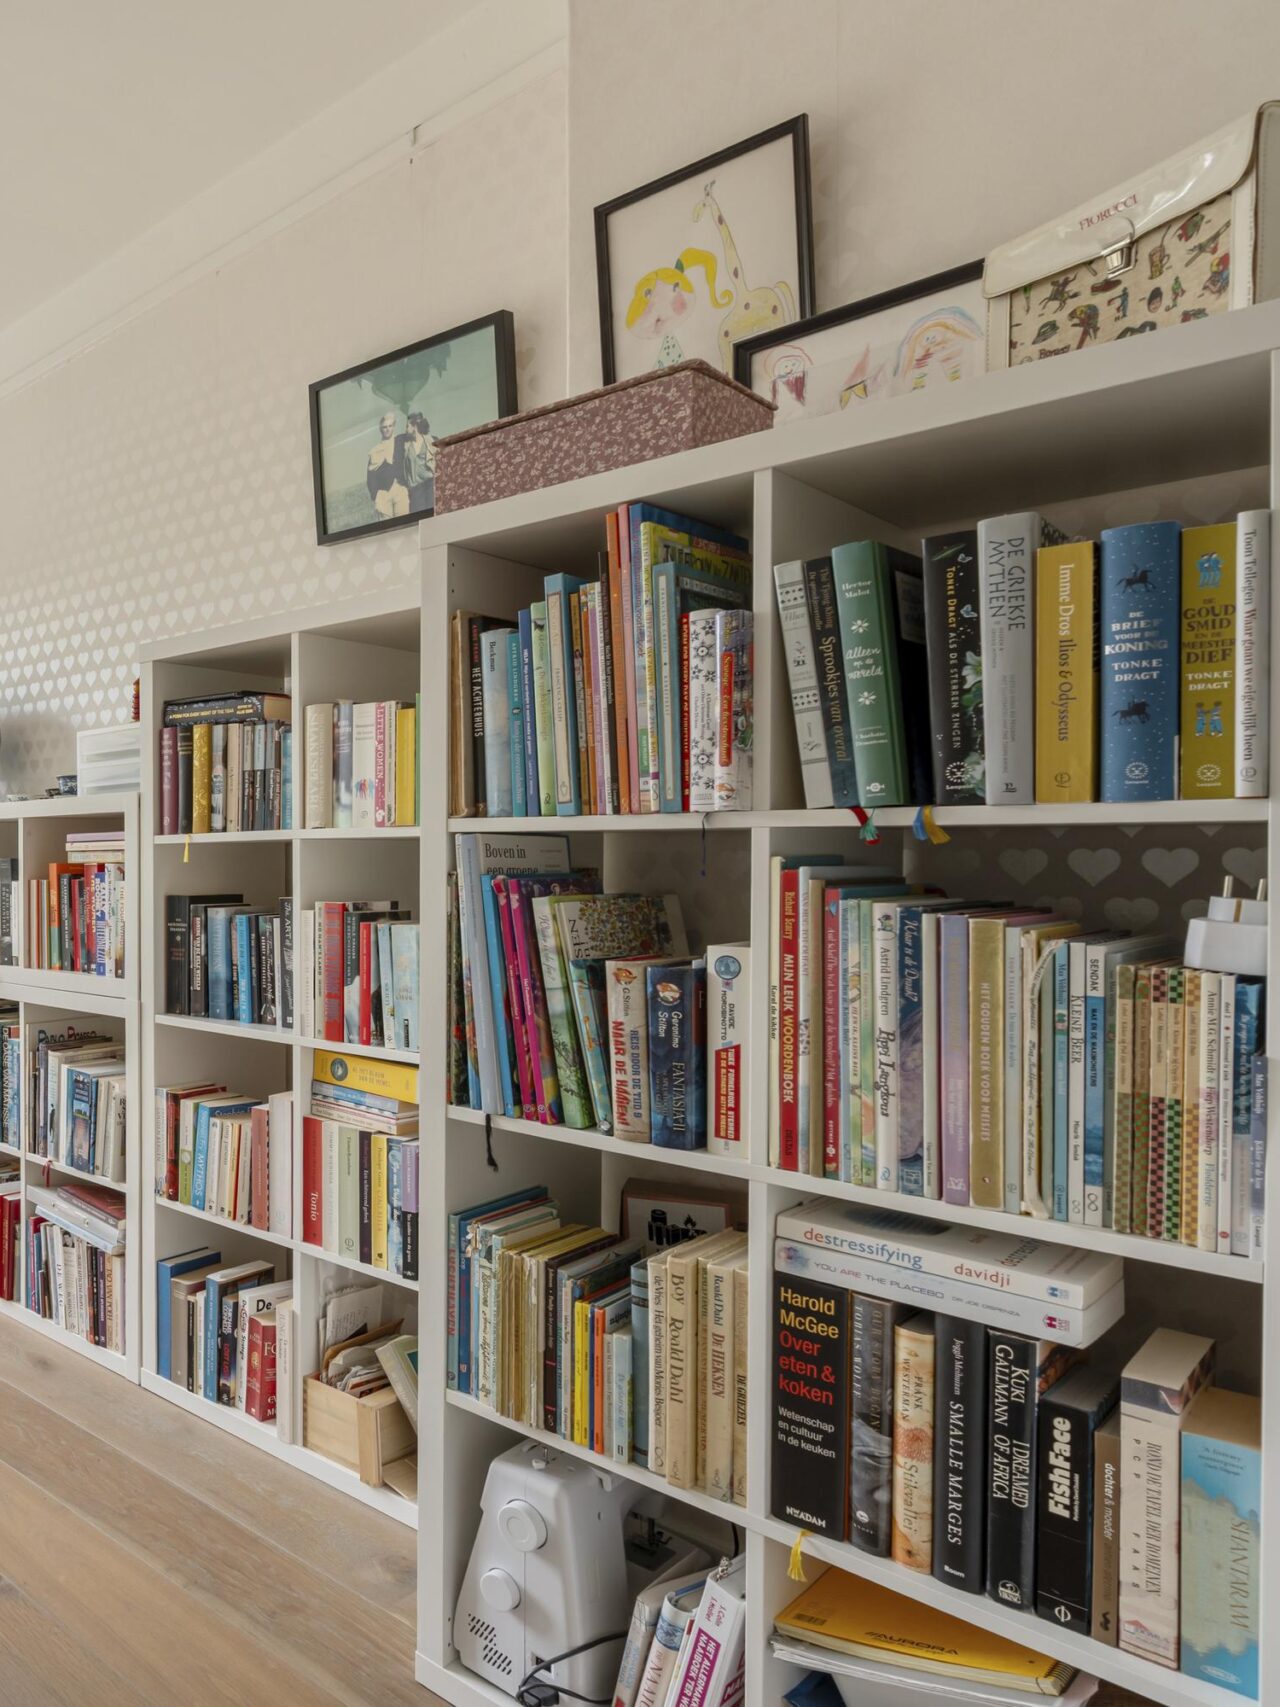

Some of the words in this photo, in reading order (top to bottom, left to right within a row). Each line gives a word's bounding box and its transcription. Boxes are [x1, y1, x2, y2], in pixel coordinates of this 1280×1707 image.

[1078, 194, 1139, 231] FIORUCCI
[1006, 536, 1025, 558] DE
[1244, 527, 1257, 558] Toon
[946, 565, 957, 596] TONKE
[987, 539, 1006, 619] MYTHEN
[1058, 563, 1075, 603] Imme
[1241, 558, 1257, 605] Tellegen
[946, 598, 958, 628] DRAGT
[1006, 564, 1026, 632] GRIEKSE
[1182, 604, 1236, 620] GOUD
[1057, 604, 1075, 637] Dros
[1110, 618, 1162, 633] BRIEF
[1185, 617, 1232, 632] SMID
[1244, 607, 1257, 637] Waar
[948, 631, 958, 649] ALS
[1058, 639, 1077, 667] Ilios
[1104, 639, 1169, 656] KONING
[1181, 638, 1236, 651] MEESTER
[1240, 638, 1254, 666] gaan
[488, 641, 498, 672] Beckman
[819, 635, 838, 698] Sprookjes
[949, 652, 959, 665] DE
[1111, 658, 1163, 671] TONKE
[1185, 648, 1233, 665] DIEF
[949, 668, 960, 709] STERREN
[1058, 669, 1072, 680] &
[1114, 670, 1161, 683] DRAGT
[1184, 670, 1234, 682] TONKE
[1187, 680, 1232, 692] DRAGT
[1243, 666, 1254, 683] we
[829, 699, 843, 722] van
[1051, 680, 1077, 742] Odysseus
[1240, 684, 1257, 732] eigenlijk
[377, 708, 385, 742] LITTLE
[950, 712, 961, 749] ZINGEN
[833, 724, 852, 762] overal
[1243, 733, 1257, 761] heen
[308, 711, 321, 813] SHAKESPEARE
[377, 742, 385, 780] WOMEN
[484, 843, 514, 861] Boven
[514, 843, 527, 860] in
[783, 891, 796, 916] Richard
[96, 920, 107, 964] INTERMEZZO
[781, 916, 796, 940] Scarry
[904, 919, 919, 946] Waar
[879, 945, 891, 975] Astrid
[904, 947, 917, 956] is
[904, 956, 917, 968] de
[783, 953, 795, 982] MIJN
[783, 984, 795, 1012] LEUK
[879, 976, 891, 1017] Lindgren
[903, 967, 919, 1003] Draak?
[980, 982, 991, 1001] HET
[720, 990, 728, 1042] MOROSINOTTO
[727, 1002, 736, 1030] DAVIDE
[1206, 990, 1218, 1016] Annie
[2, 1027, 10, 1041] DE
[612, 1020, 626, 1056] NAAR
[657, 1010, 669, 1038] Stilton
[671, 1010, 683, 1049] Geronimo
[980, 1002, 991, 1044] GOUDEN
[1206, 1016, 1217, 1038] M.G.
[2, 1041, 10, 1068] OASE
[630, 1029, 640, 1050] REIS
[875, 1027, 897, 1058] Pippi
[616, 1060, 626, 1075] DE
[631, 1051, 641, 1076] DOOR
[727, 1047, 736, 1065] TWEE
[782, 1014, 795, 1104] WOORDENBOEK
[980, 1045, 991, 1073] BOEK
[1206, 1038, 1218, 1075] Schmidt
[2, 1068, 10, 1090] VAN
[632, 1077, 641, 1090] DE
[726, 1067, 736, 1107] FONKELRODE
[872, 1060, 896, 1119] Langkous
[980, 1074, 991, 1104] VOOR
[1206, 1076, 1216, 1085] &
[2, 1088, 10, 1129] MATISSE
[615, 1078, 631, 1127] HAAIEN!
[633, 1090, 642, 1109] TIJD
[1204, 1085, 1218, 1105] Fiep
[634, 1111, 643, 1119] 9
[726, 1109, 736, 1139] STERREN
[980, 1104, 991, 1143] MEISJES
[1204, 1105, 1217, 1156] Westendorp
[194, 1152, 205, 1197] MYTHOS
[362, 1168, 370, 1179] Een
[1202, 1162, 1216, 1208] Floddertje
[309, 1190, 320, 1223] Tonio
[56, 1262, 64, 1273] DE
[802, 1226, 923, 1272] destressifying
[952, 1262, 1010, 1288] davidji
[57, 1282, 65, 1307] WEG
[713, 1274, 725, 1302] Roald
[779, 1286, 836, 1316] Harold
[221, 1304, 229, 1336] CONNELLY
[256, 1298, 274, 1312] De
[713, 1302, 725, 1327] Dahl
[779, 1308, 840, 1340] McGee
[853, 1304, 865, 1351] TOBIAS
[711, 1332, 724, 1348] DE
[778, 1330, 822, 1357] Over
[711, 1348, 726, 1400] HEKSEN
[736, 1373, 747, 1387] DE
[778, 1353, 818, 1380] eten
[820, 1364, 837, 1385] &
[853, 1354, 863, 1400] WOLFF
[1011, 1364, 1030, 1404] KUKI
[778, 1374, 834, 1406] koken
[901, 1358, 912, 1423] WESTERMAN
[913, 1375, 924, 1411] FRANK
[993, 1343, 1014, 1427] GALLMANN
[736, 1386, 747, 1427] GRIEZELS
[778, 1405, 835, 1434] Wetenschap
[777, 1431, 787, 1442] in
[787, 1434, 800, 1447] de
[801, 1438, 837, 1459] keuken
[778, 1420, 790, 1431] en
[790, 1421, 824, 1442] cultuur
[949, 1400, 964, 1471] SMALLE
[993, 1432, 1010, 1453] OF
[1012, 1438, 1030, 1448] I
[1047, 1415, 1072, 1519] FishFace
[1145, 1441, 1162, 1474] ROND
[992, 1455, 1010, 1501] AFRICA
[1011, 1446, 1030, 1509] DREAMED
[1103, 1462, 1117, 1499] dochter
[1145, 1472, 1161, 1488] DE
[947, 1472, 963, 1546] MARGES
[1103, 1498, 1114, 1506] &
[1145, 1487, 1162, 1520] TAFEL
[1103, 1506, 1115, 1541] moeder
[1145, 1519, 1162, 1542] DER
[943, 1564, 965, 1579] Boom
[1229, 1517, 1250, 1632] SHANTARAM
[875, 1632, 961, 1657] AURORA
